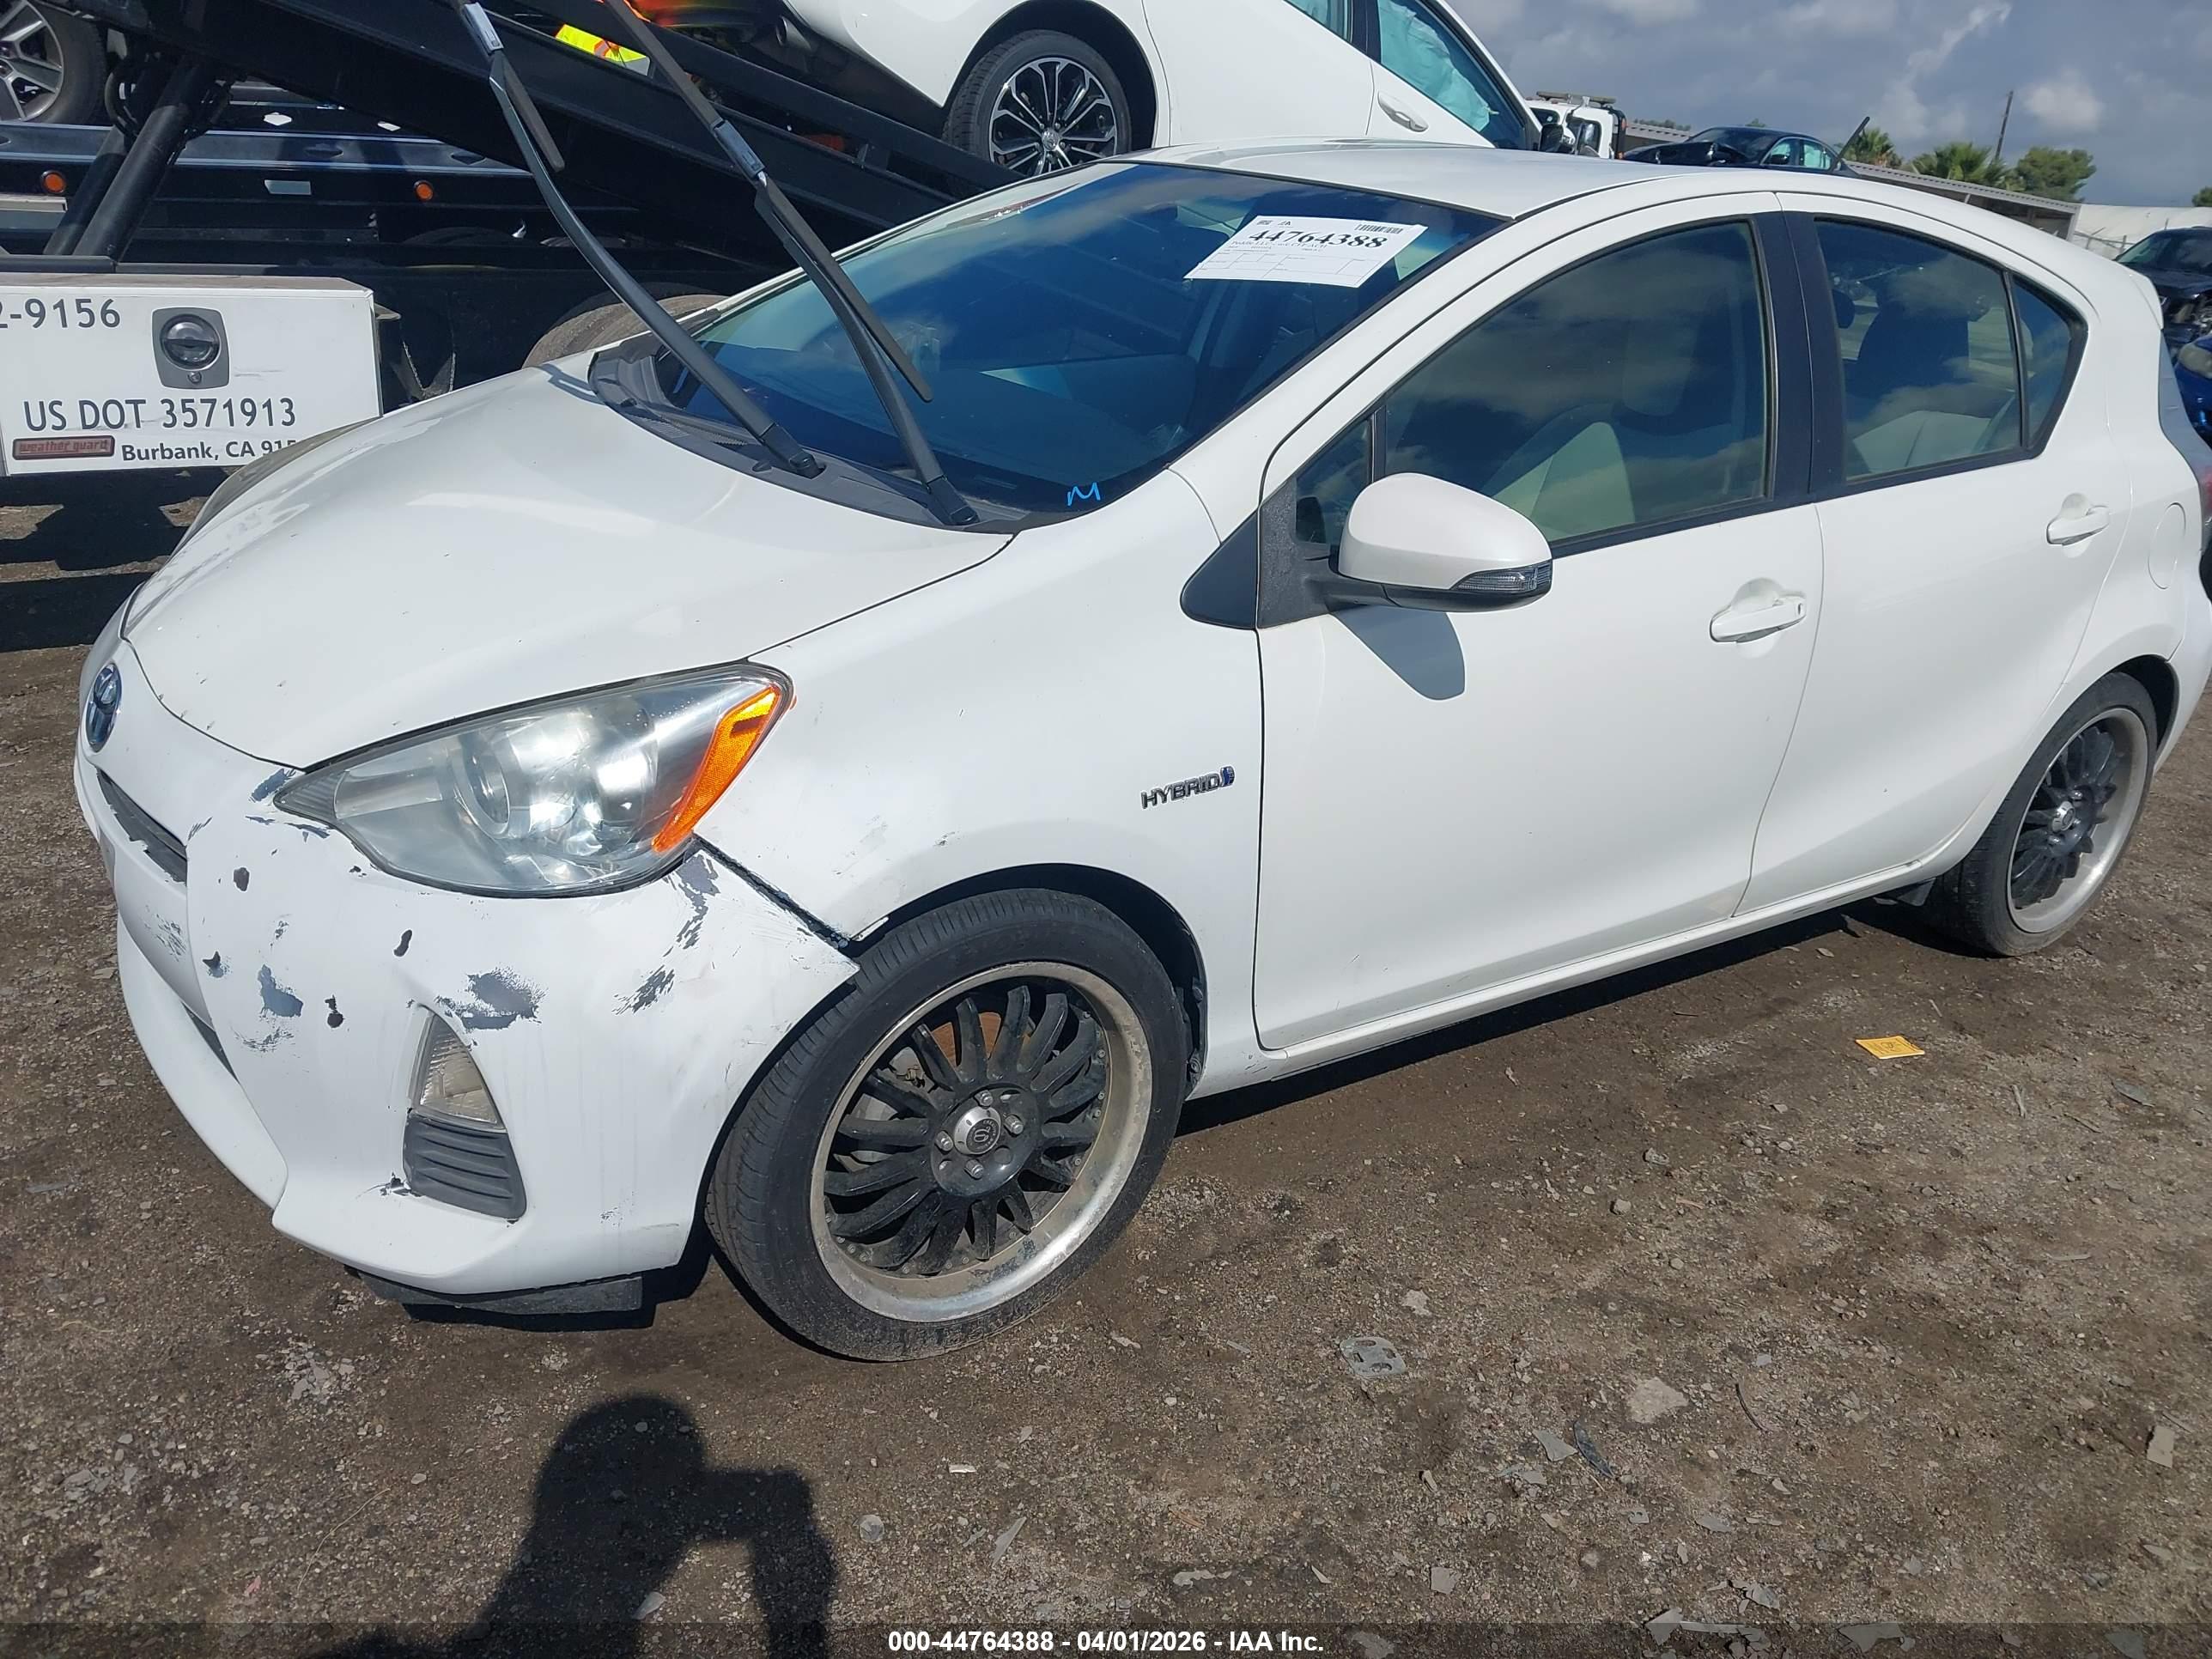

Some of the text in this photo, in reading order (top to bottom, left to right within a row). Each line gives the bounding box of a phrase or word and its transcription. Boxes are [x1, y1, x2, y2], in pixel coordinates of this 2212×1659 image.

[1249, 229, 1388, 248] 44764388
[24, 398, 295, 431] US DOT 3571913
[122, 441, 218, 461] Burbank,
[226, 441, 255, 457] CA
[1140, 773, 1221, 810] HYBRID
